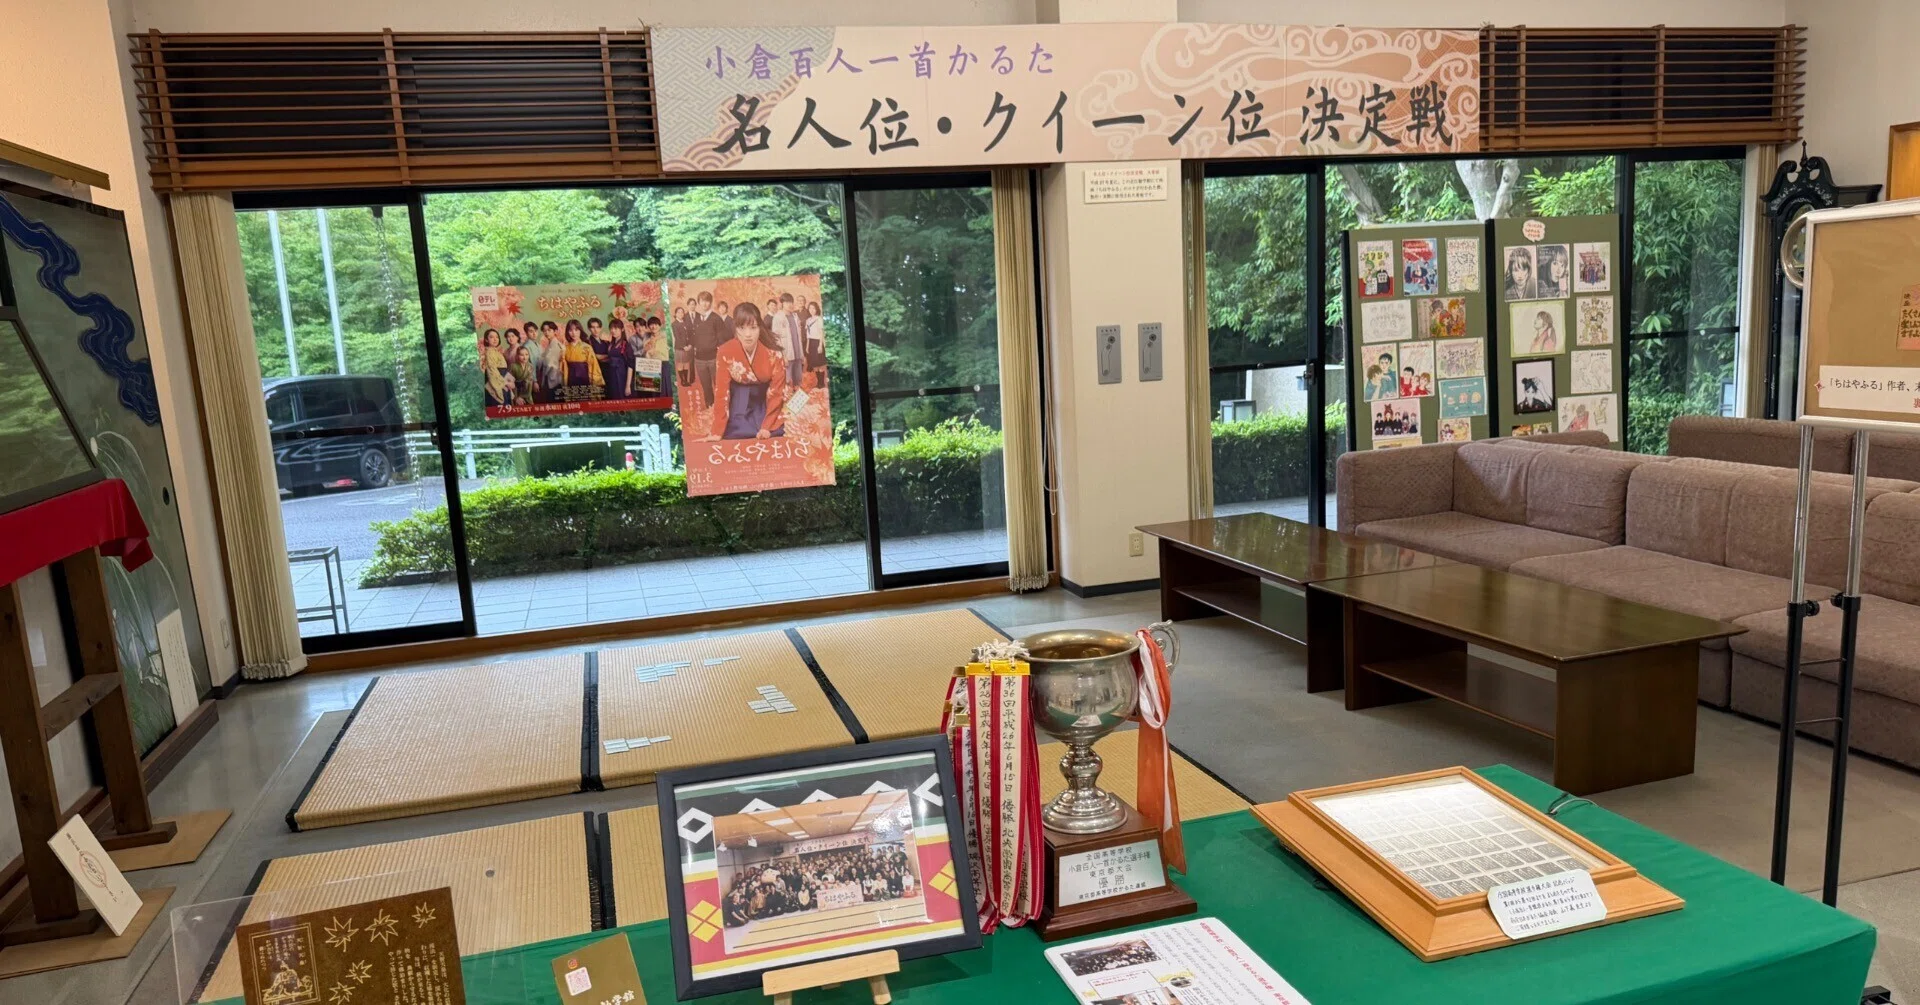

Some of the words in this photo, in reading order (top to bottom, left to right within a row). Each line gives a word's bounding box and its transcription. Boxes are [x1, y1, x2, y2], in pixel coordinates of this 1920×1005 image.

[705, 42, 1055, 79] 小倉百人一首かるた
[714, 87, 1270, 155] 名人位・クイーン位
[1298, 82, 1453, 149] 決定戦
[538, 295, 601, 310] ちはやふる
